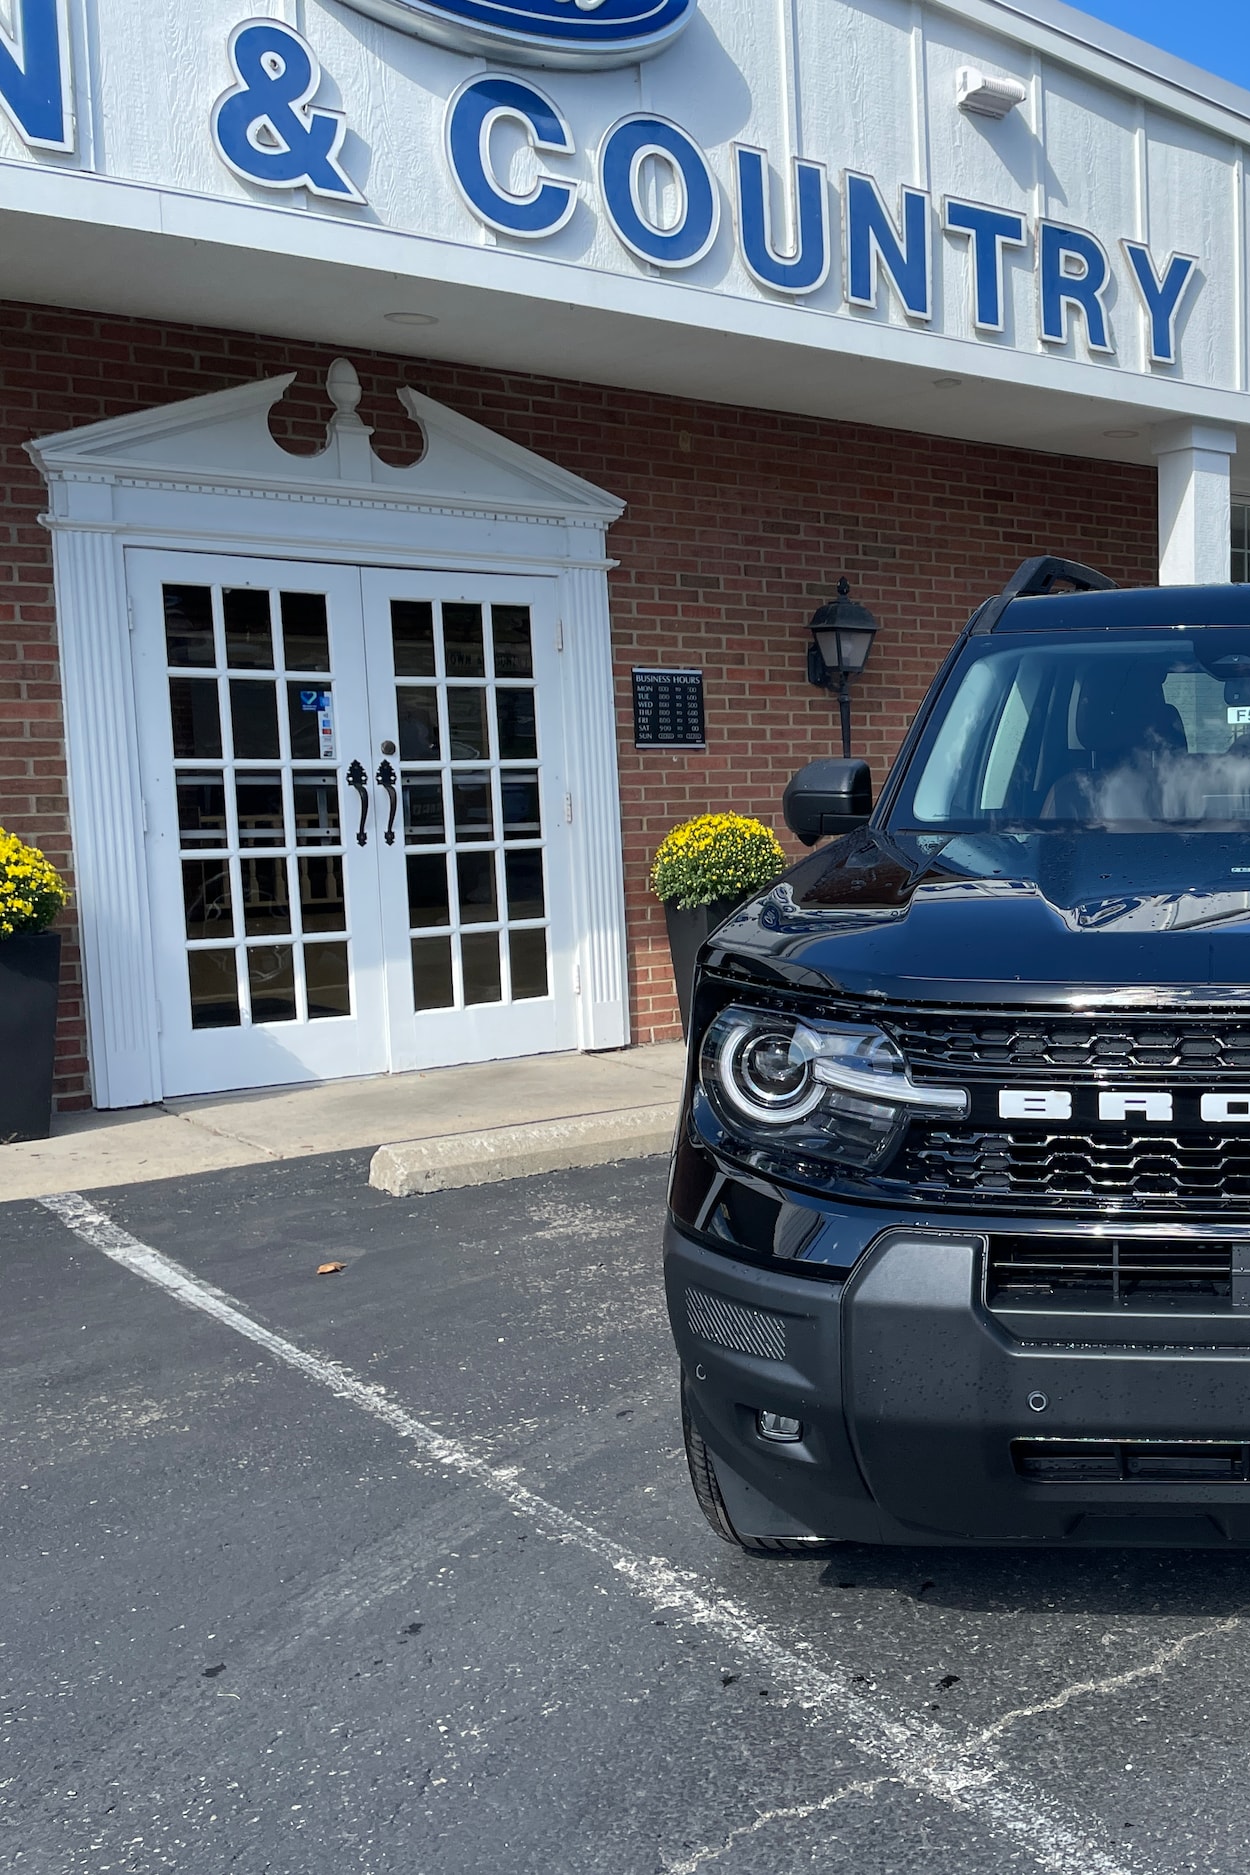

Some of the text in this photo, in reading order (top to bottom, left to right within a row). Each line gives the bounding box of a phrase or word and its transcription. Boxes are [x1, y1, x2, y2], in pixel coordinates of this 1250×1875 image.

[210, 16, 367, 205] &
[446, 71, 1200, 364] COUNTRY
[635, 674, 700, 685] BUSINESS HOURS
